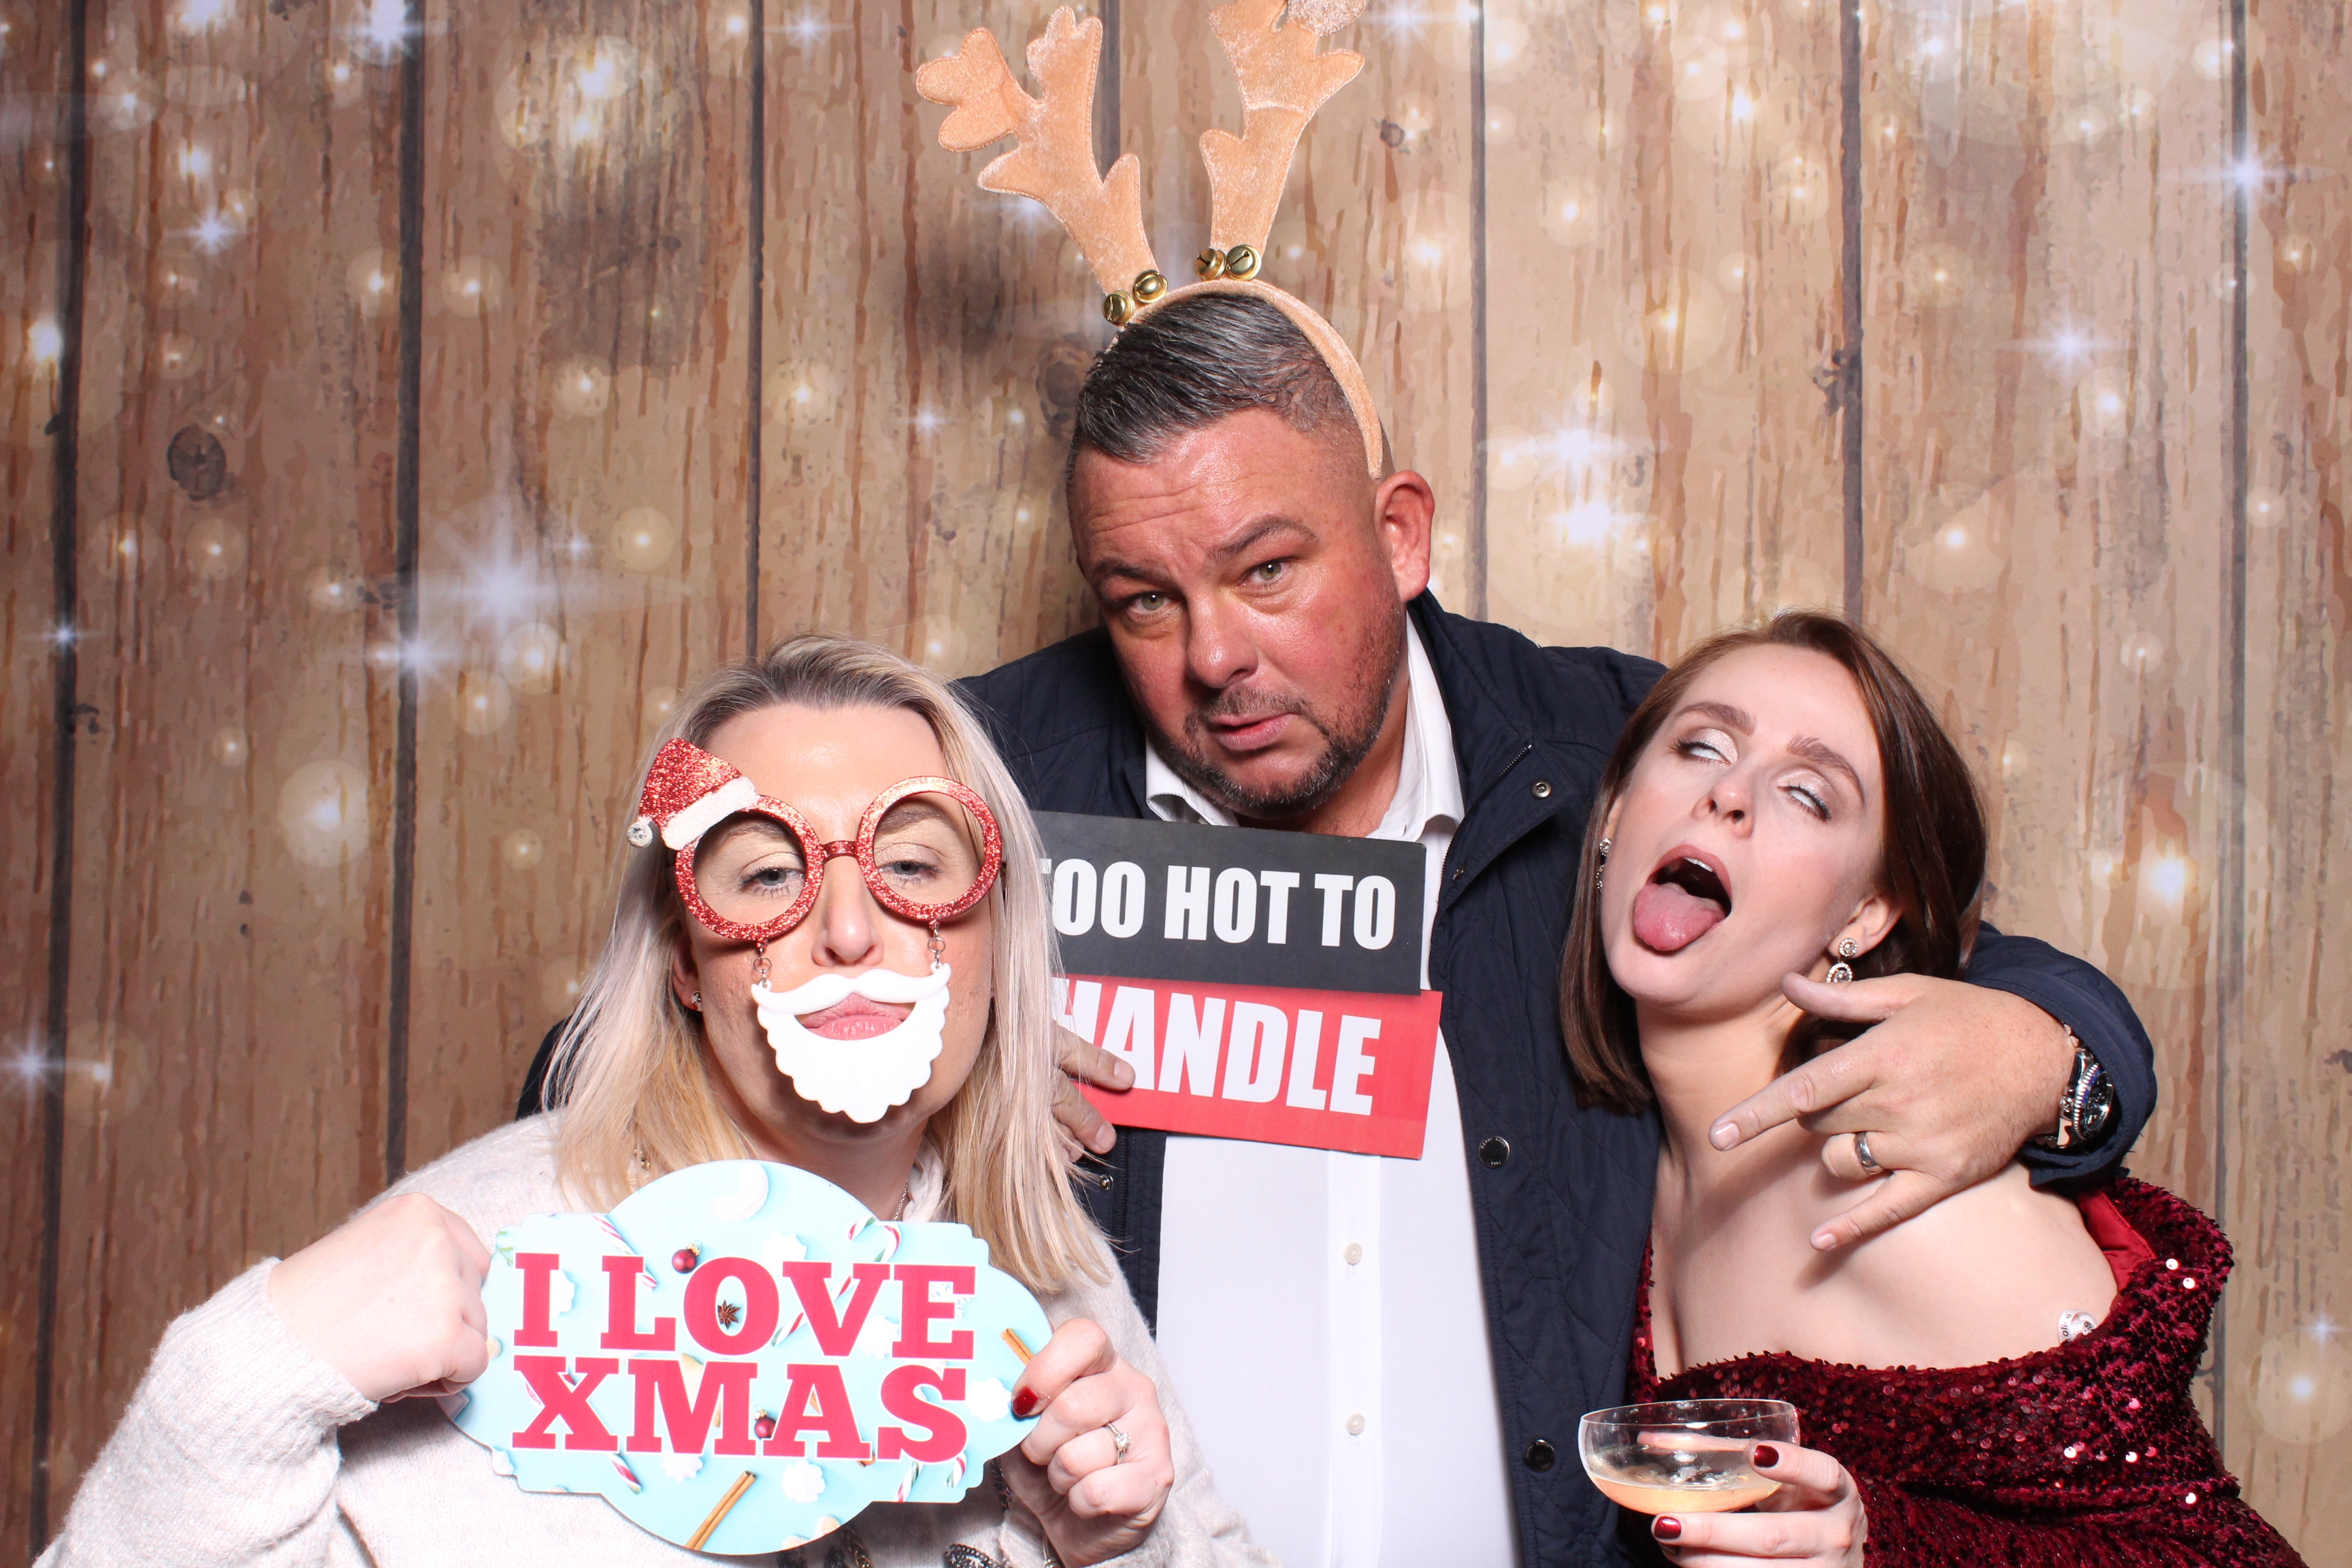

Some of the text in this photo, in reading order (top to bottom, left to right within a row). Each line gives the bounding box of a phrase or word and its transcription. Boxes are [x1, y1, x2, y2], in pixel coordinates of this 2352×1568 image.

[1038, 858, 1396, 950] OO HOT TO
[514, 1252, 976, 1360] I LOVE
[512, 1355, 968, 1463] XMAS
